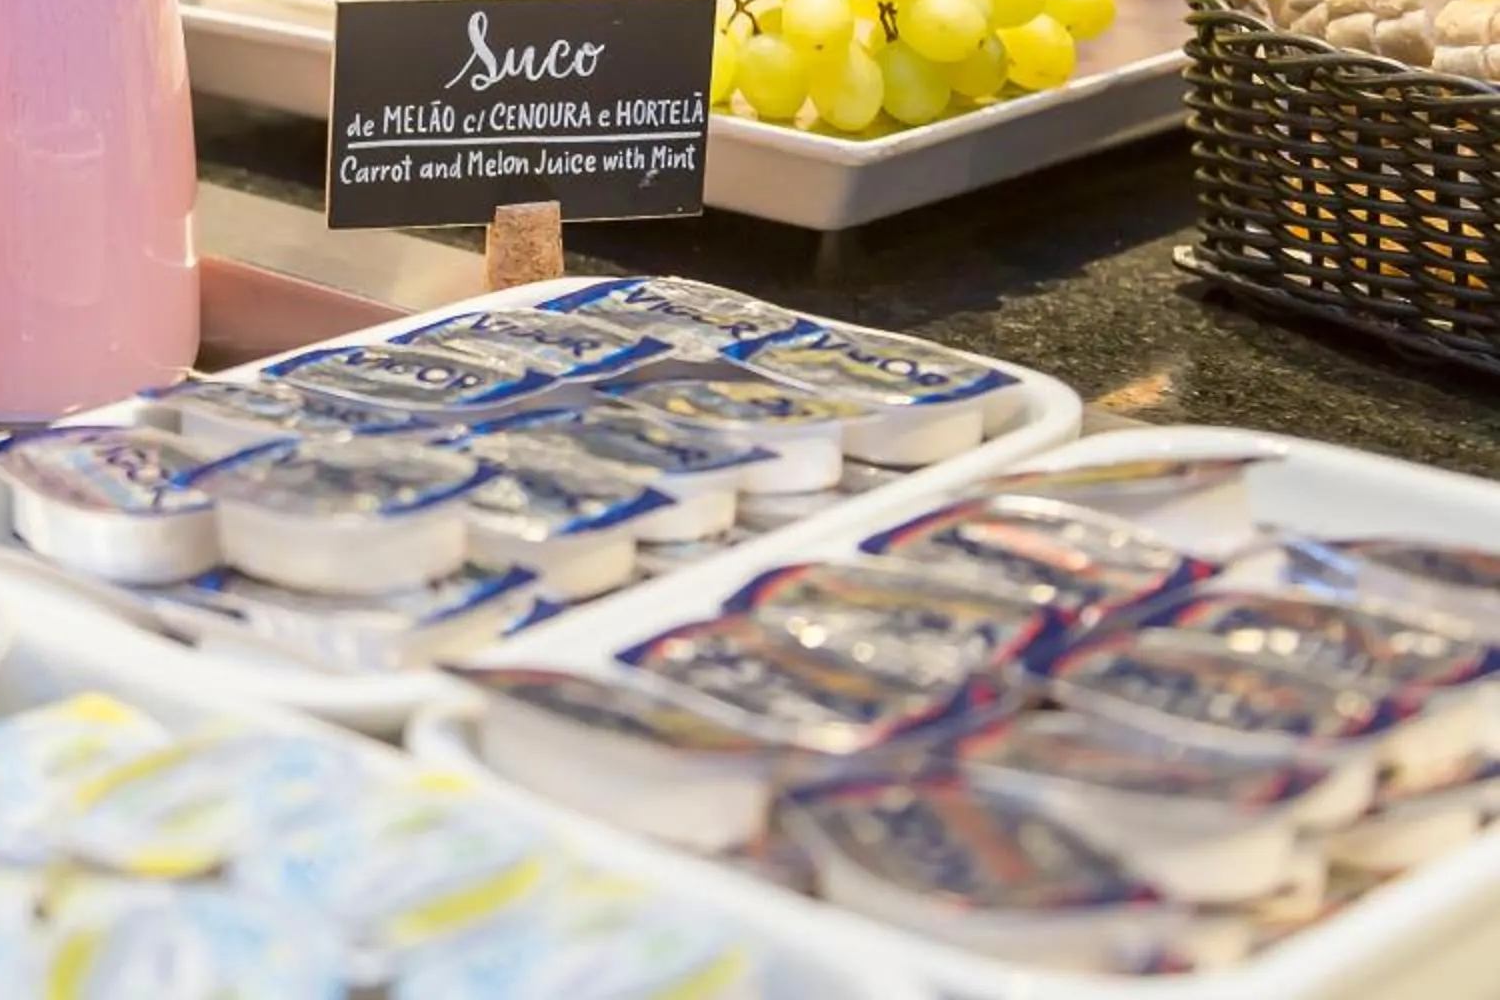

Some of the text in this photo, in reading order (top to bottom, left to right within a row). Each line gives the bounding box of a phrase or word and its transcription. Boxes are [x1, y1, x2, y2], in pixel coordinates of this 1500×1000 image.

[444, 11, 605, 92] Suco
[346, 91, 704, 137] de MELÃO c/ CENOURA e HORTELÃ
[340, 143, 696, 185] Carrot and Melon Juice with Mint
